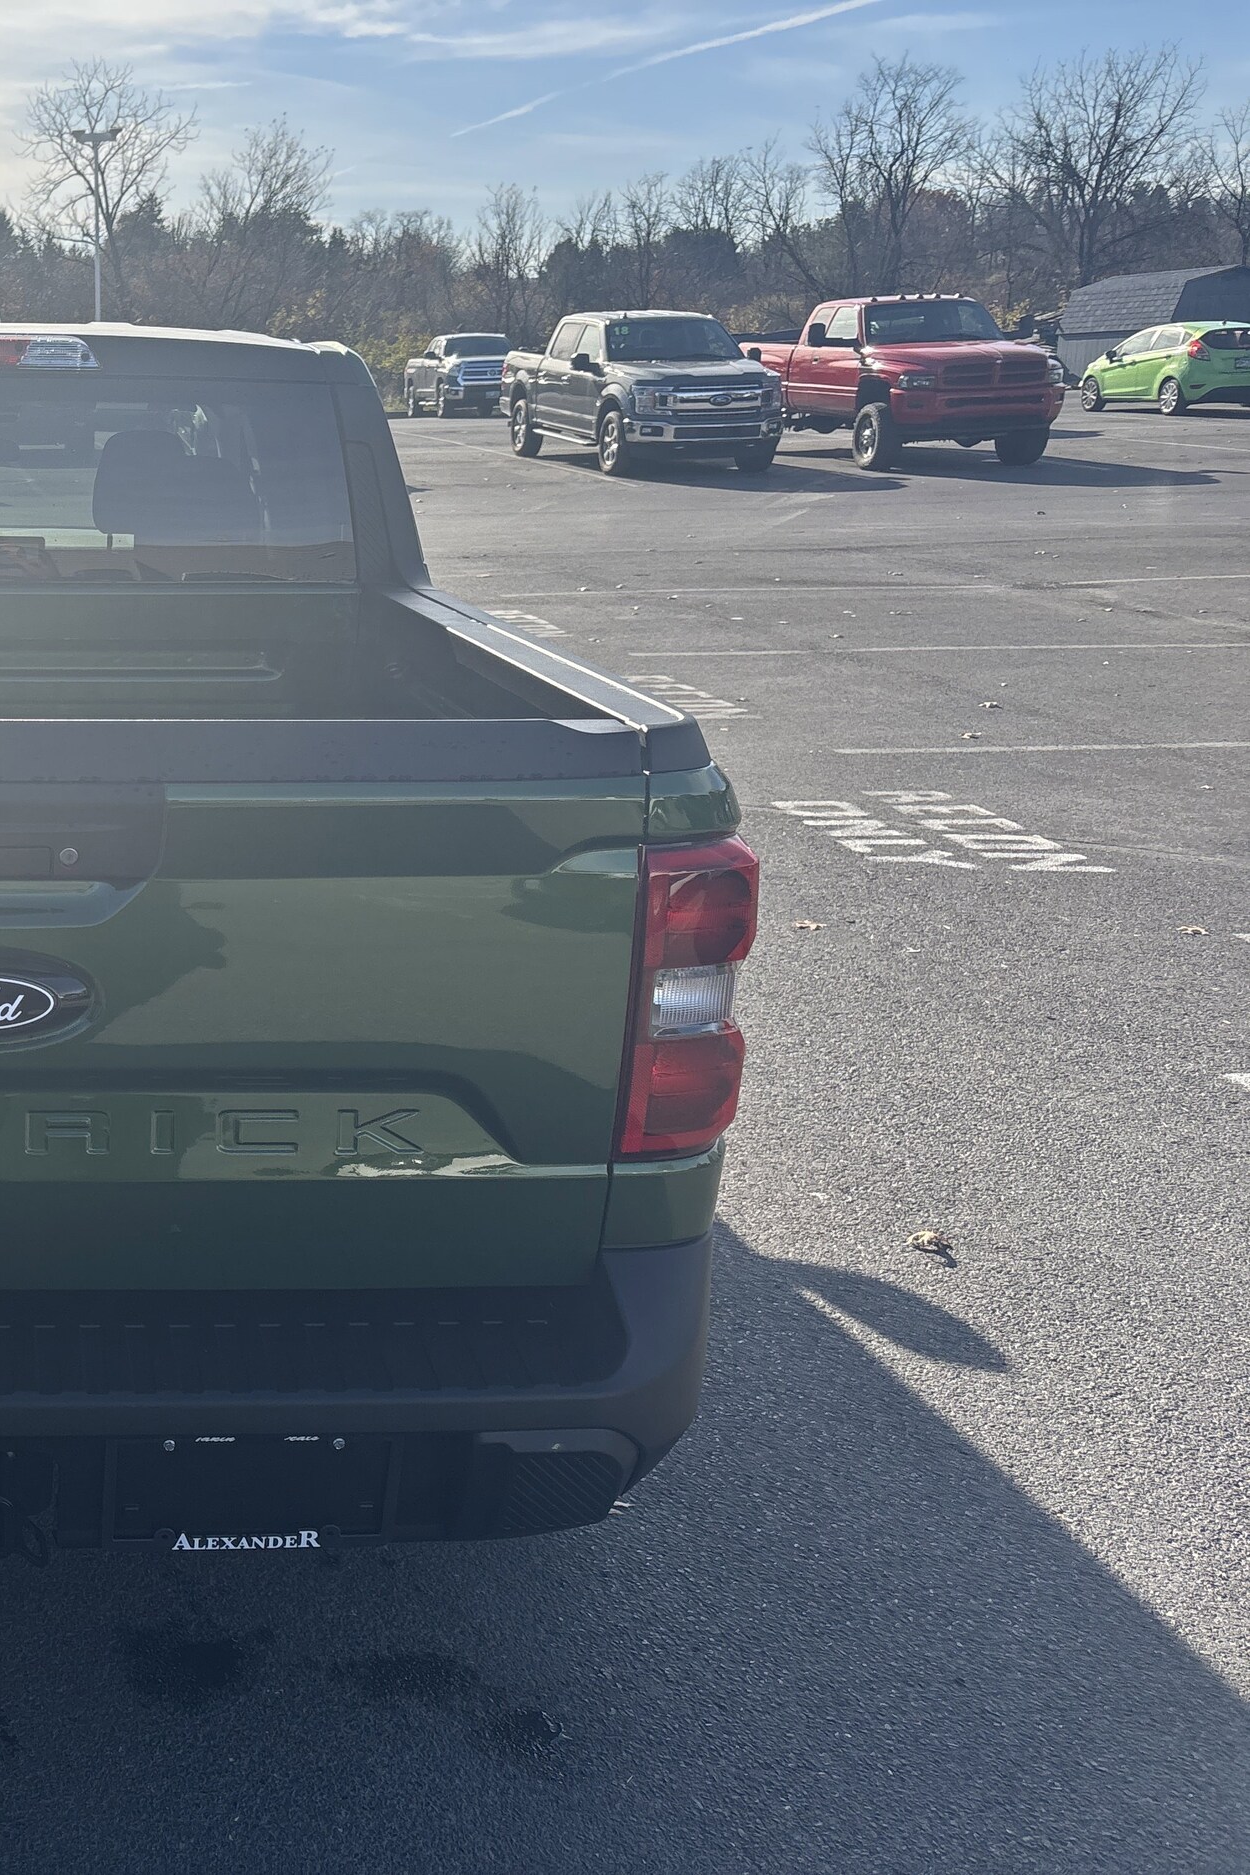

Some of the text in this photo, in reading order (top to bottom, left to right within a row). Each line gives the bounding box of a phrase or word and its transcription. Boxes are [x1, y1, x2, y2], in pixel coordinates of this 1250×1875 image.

[614, 326, 629, 336] 18
[770, 801, 978, 870] ONLY
[861, 790, 1117, 873] RECON
[172, 1530, 321, 1551] ALEXANDER
